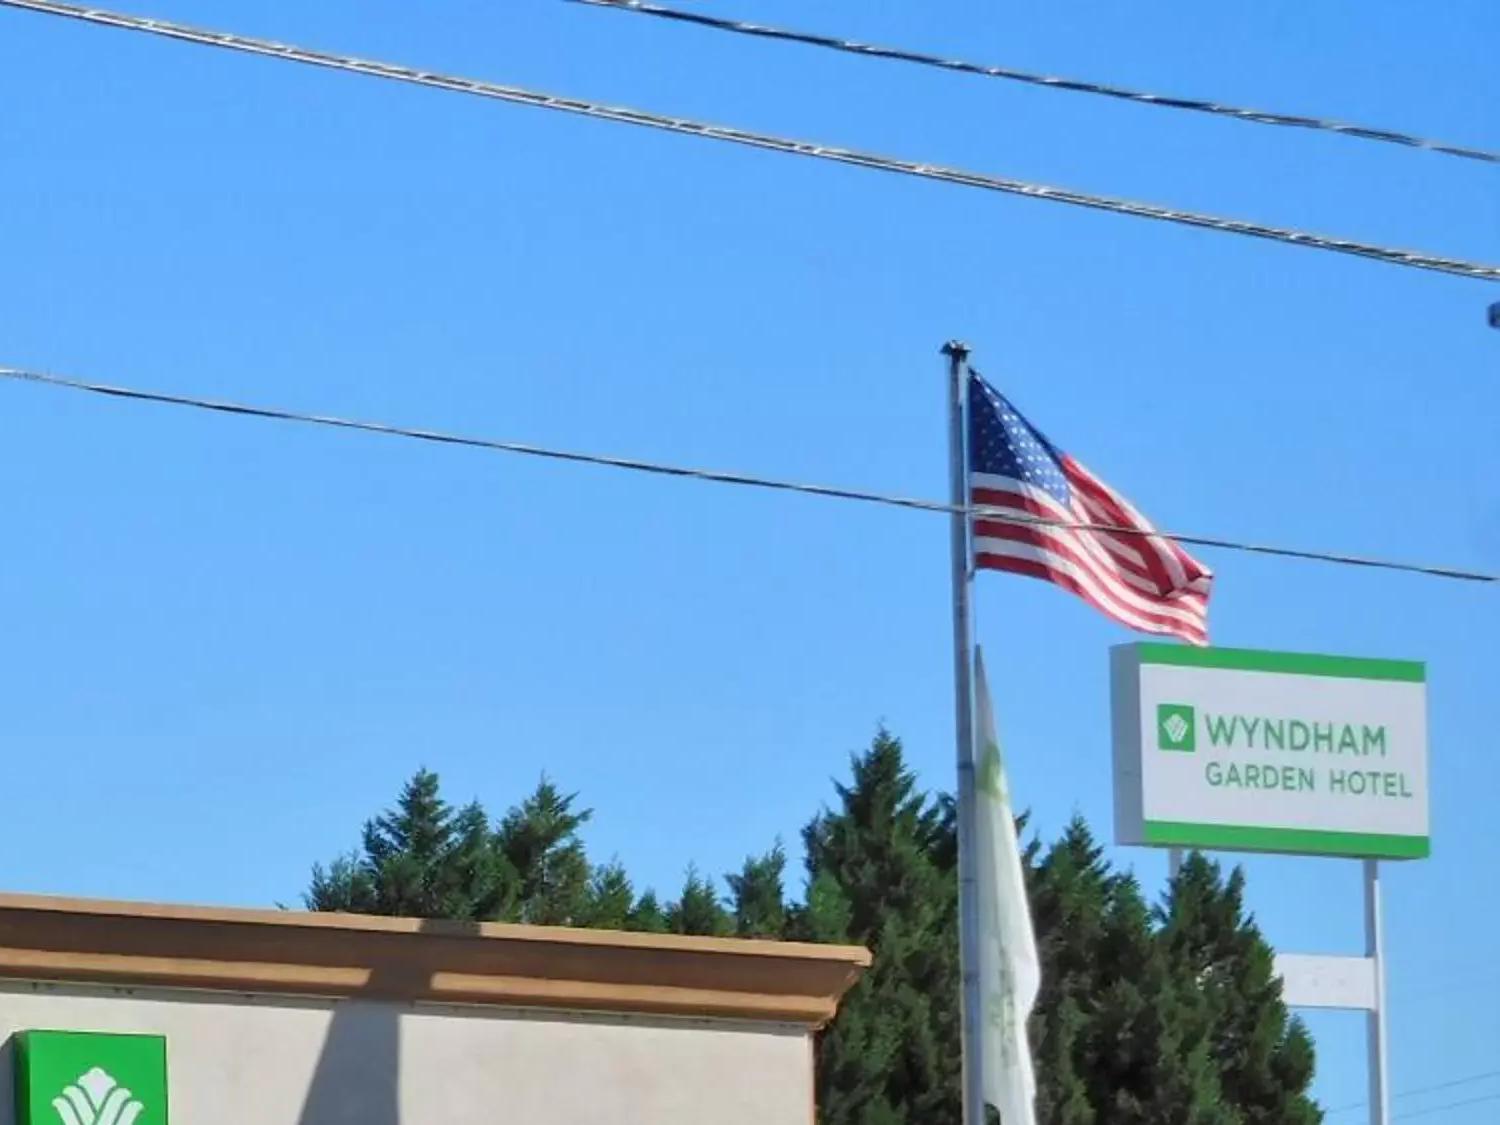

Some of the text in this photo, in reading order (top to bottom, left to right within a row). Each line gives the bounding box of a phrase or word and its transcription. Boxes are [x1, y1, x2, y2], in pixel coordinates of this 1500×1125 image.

[1204, 714, 1386, 756] WYNDHAM
[1205, 761, 1413, 798] GARDEN HOTEL
